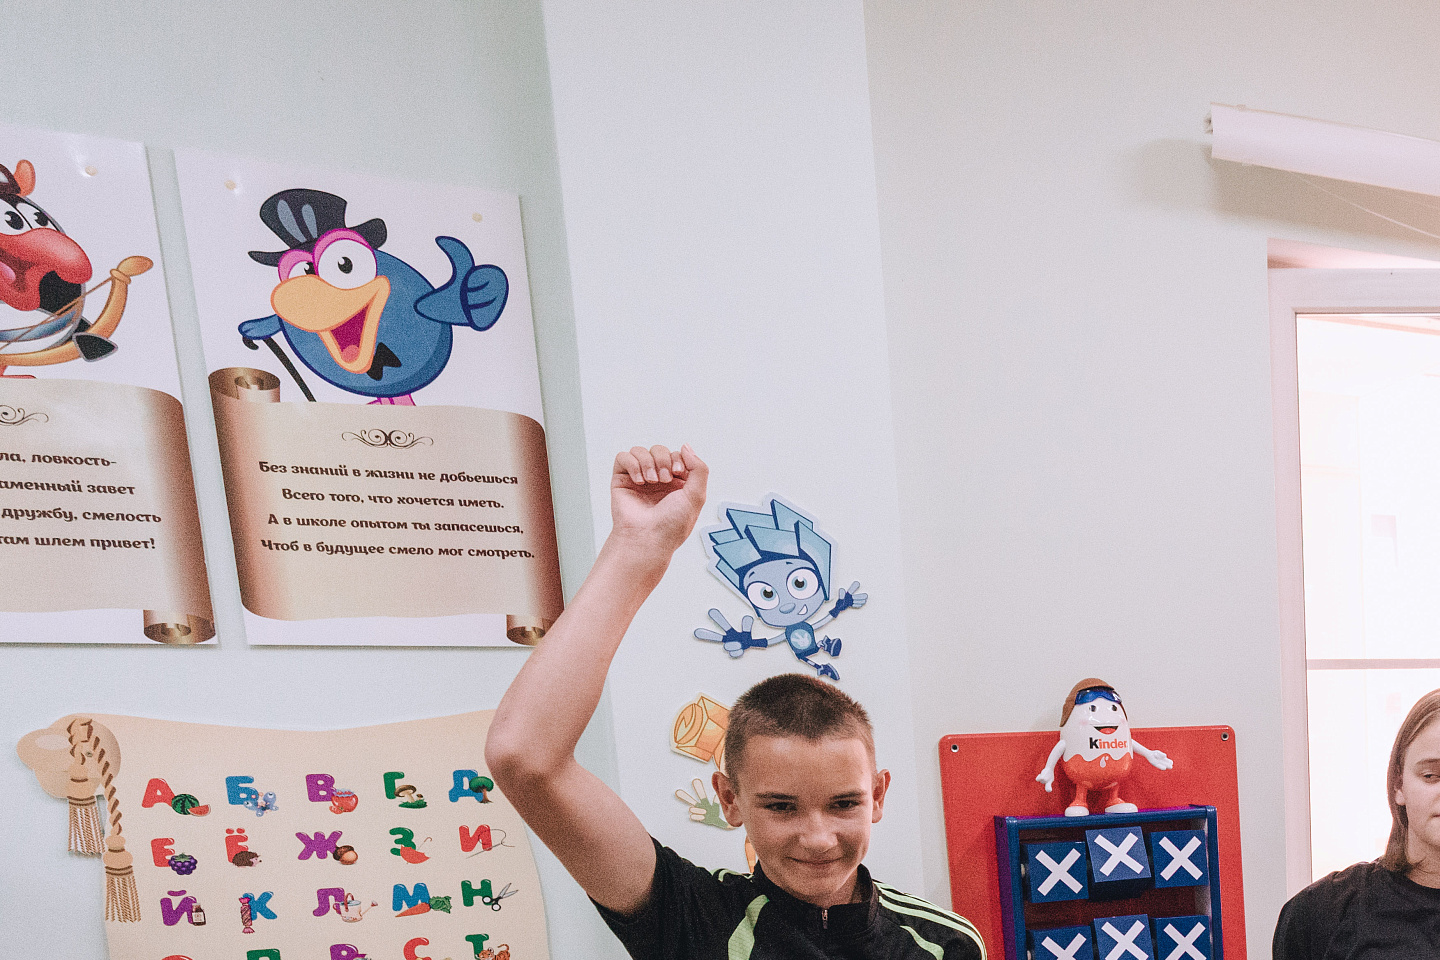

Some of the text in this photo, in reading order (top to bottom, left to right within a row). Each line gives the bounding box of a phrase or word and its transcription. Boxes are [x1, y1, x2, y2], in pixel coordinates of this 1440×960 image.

[31, 454, 117, 467] ловкость-
[258, 461, 519, 484] Без знаний в жизни не добьешься
[87, 484, 136, 495] завет
[282, 488, 504, 509] Всего того, что хочется иметь.
[1, 507, 162, 523] дружбу, смелость
[267, 513, 524, 534] А в школе опытом ты запасешься,
[34, 536, 86, 547] шлем
[90, 538, 155, 550] привет!
[260, 539, 535, 560] Чтоб в будущее смело мог смотреть.
[141, 769, 484, 808] А Б В Г Д
[150, 824, 492, 867] Е Ё Ж З И
[160, 879, 493, 926] Й К Л М Н
[464, 933, 490, 960] Т
